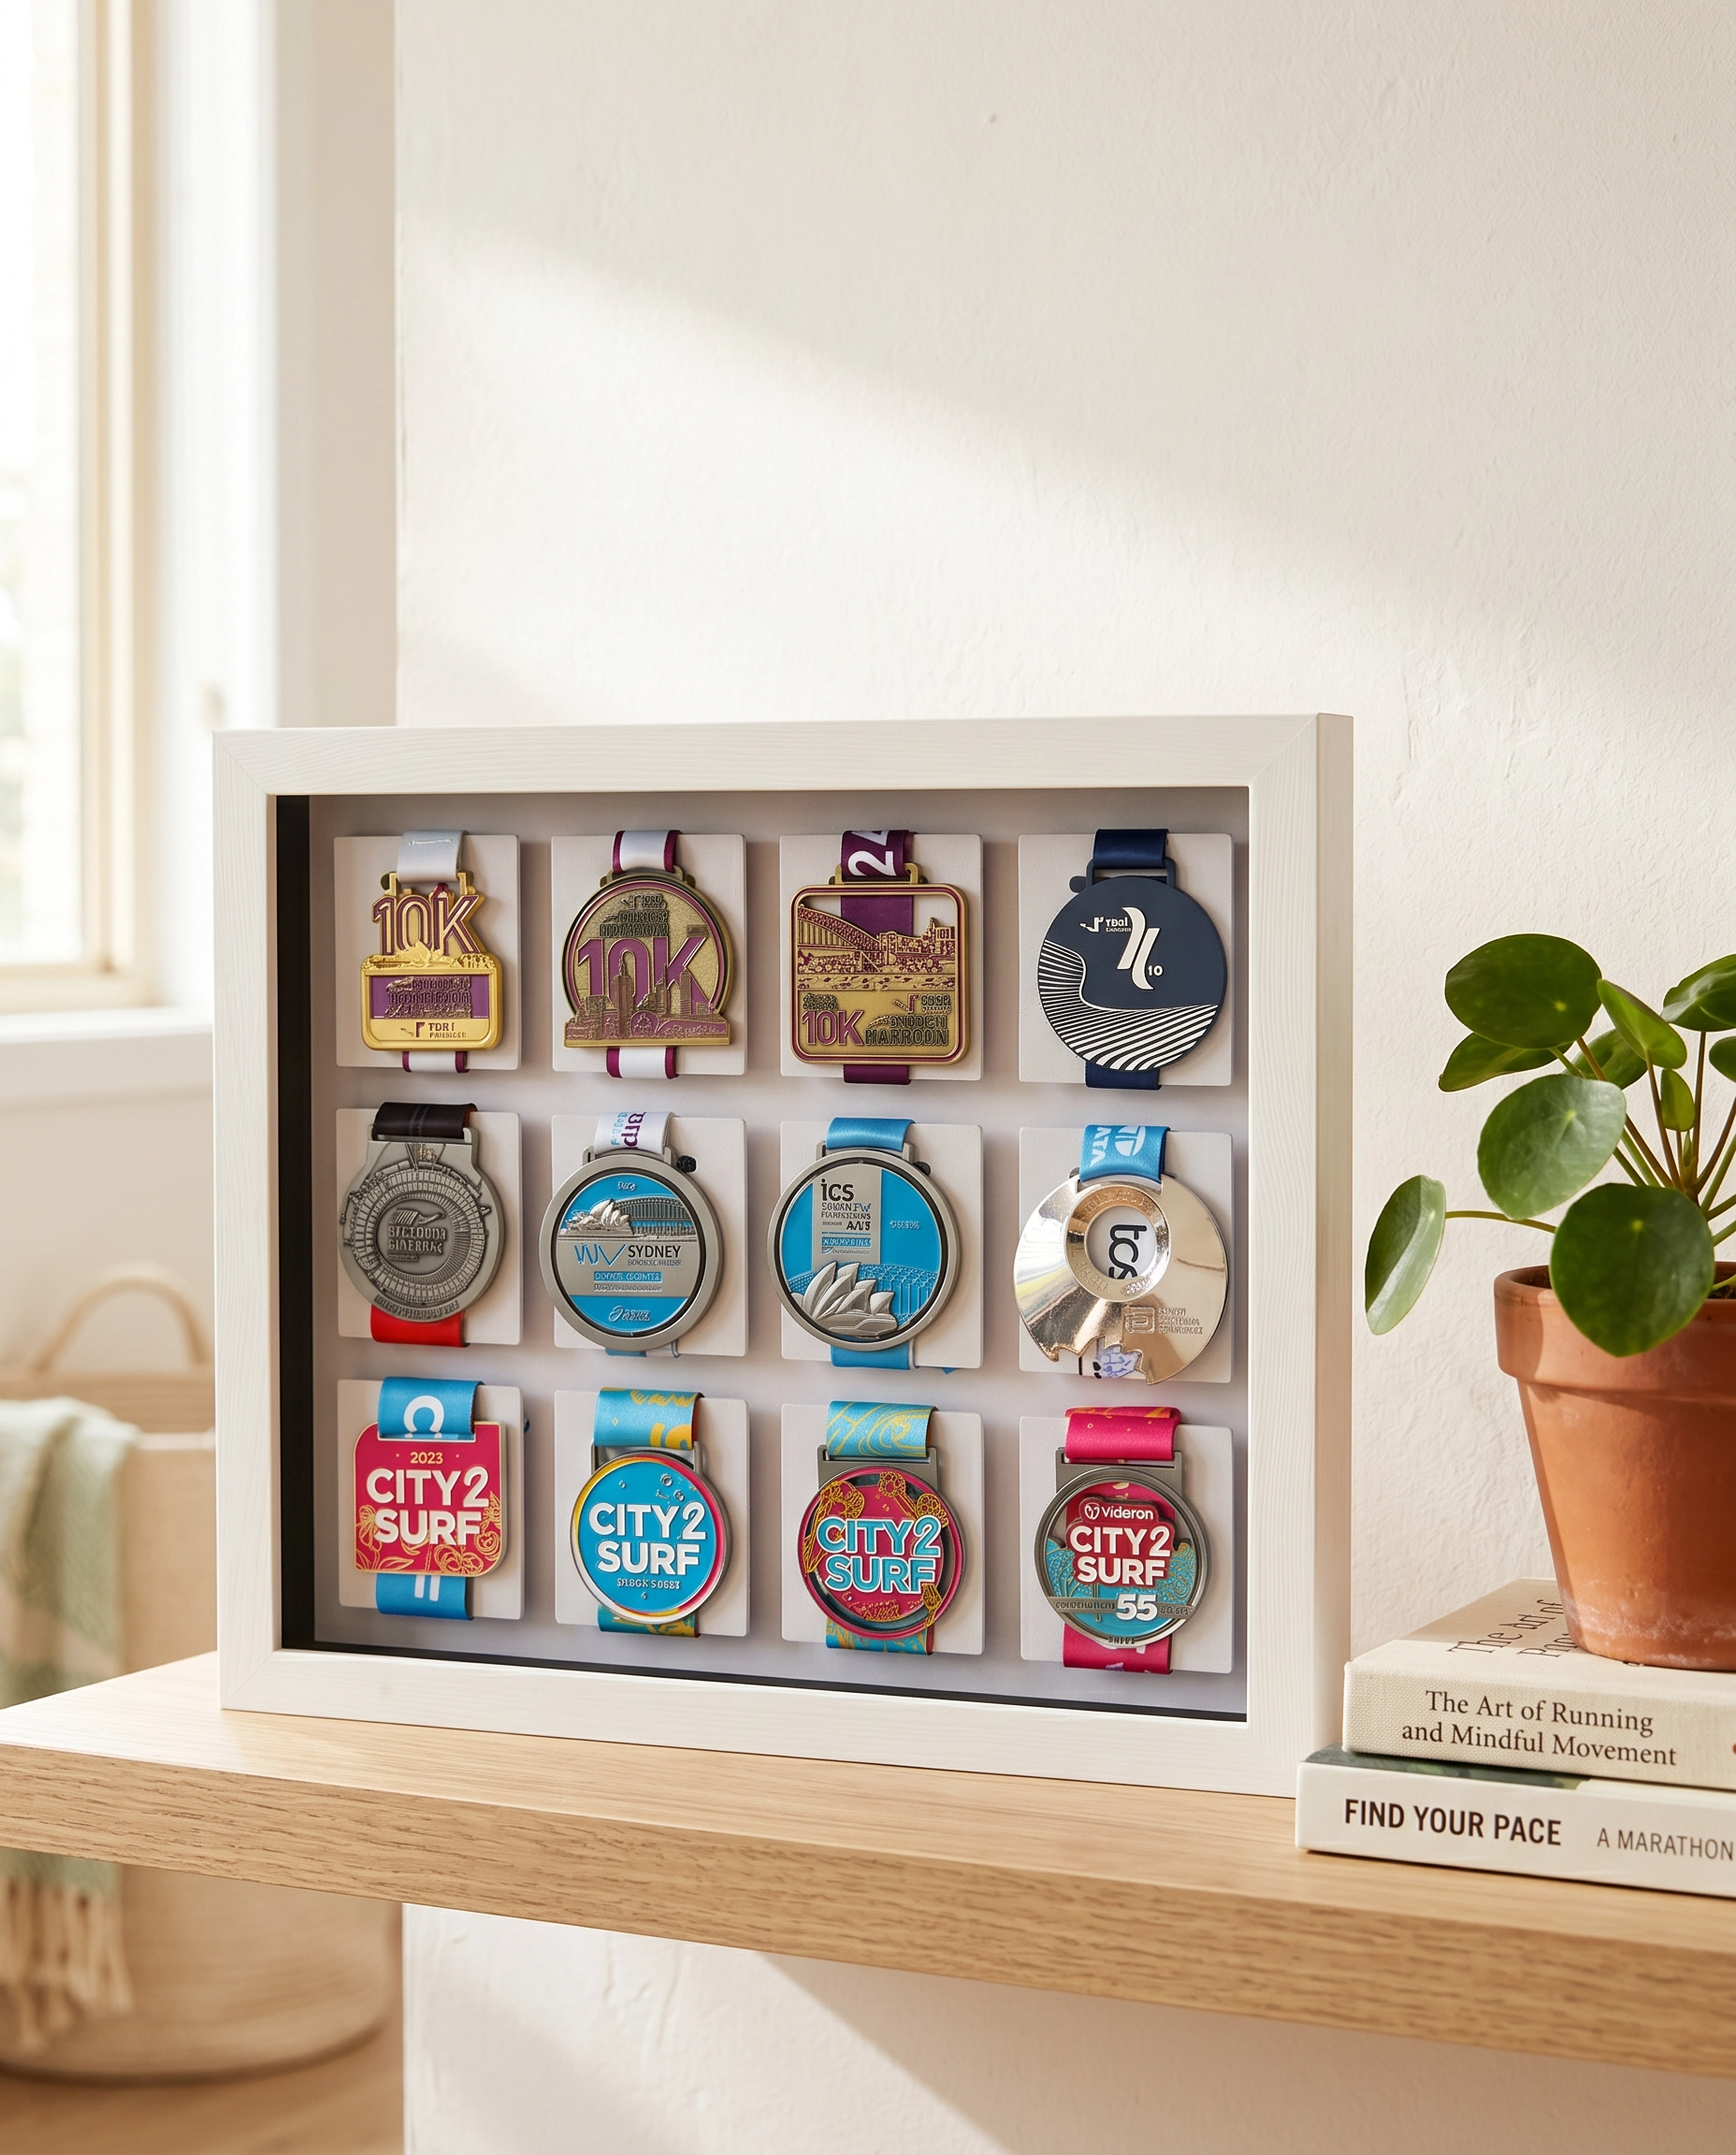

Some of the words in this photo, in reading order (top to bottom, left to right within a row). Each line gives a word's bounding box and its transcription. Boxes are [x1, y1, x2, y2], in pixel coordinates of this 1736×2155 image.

[372, 895, 481, 957] 10K
[577, 937, 711, 1013] 10K
[1148, 965, 1164, 976] 10
[801, 1010, 864, 1046] 10K
[628, 1244, 682, 1258] SYDNEY
[410, 1452, 443, 1465] 2023
[366, 1466, 489, 1509] CITY2
[374, 1508, 482, 1545] SURF
[588, 1501, 707, 1540] CITY2
[1101, 1505, 1154, 1520] Videron
[816, 1515, 942, 1558] CITY2
[1070, 1526, 1171, 1557] CITY2
[597, 1541, 700, 1576] SURF
[825, 1555, 936, 1595] SURF
[1078, 1555, 1165, 1585] SURF
[1116, 1593, 1158, 1622] 55
[1425, 1690, 1468, 1714] The
[1476, 1696, 1513, 1718] Art
[1521, 1700, 1545, 1721] of
[1552, 1701, 1654, 1737] Running
[1402, 1722, 1443, 1743] and
[1452, 1725, 1544, 1754] Mindful
[1552, 1734, 1677, 1766] Movement
[1344, 1799, 1405, 1829] FIND
[1413, 1805, 1484, 1839] YOUR
[1494, 1814, 1562, 1846] PACE
[1597, 1828, 1610, 1848] A
[1617, 1829, 1733, 1861] MARATHON
